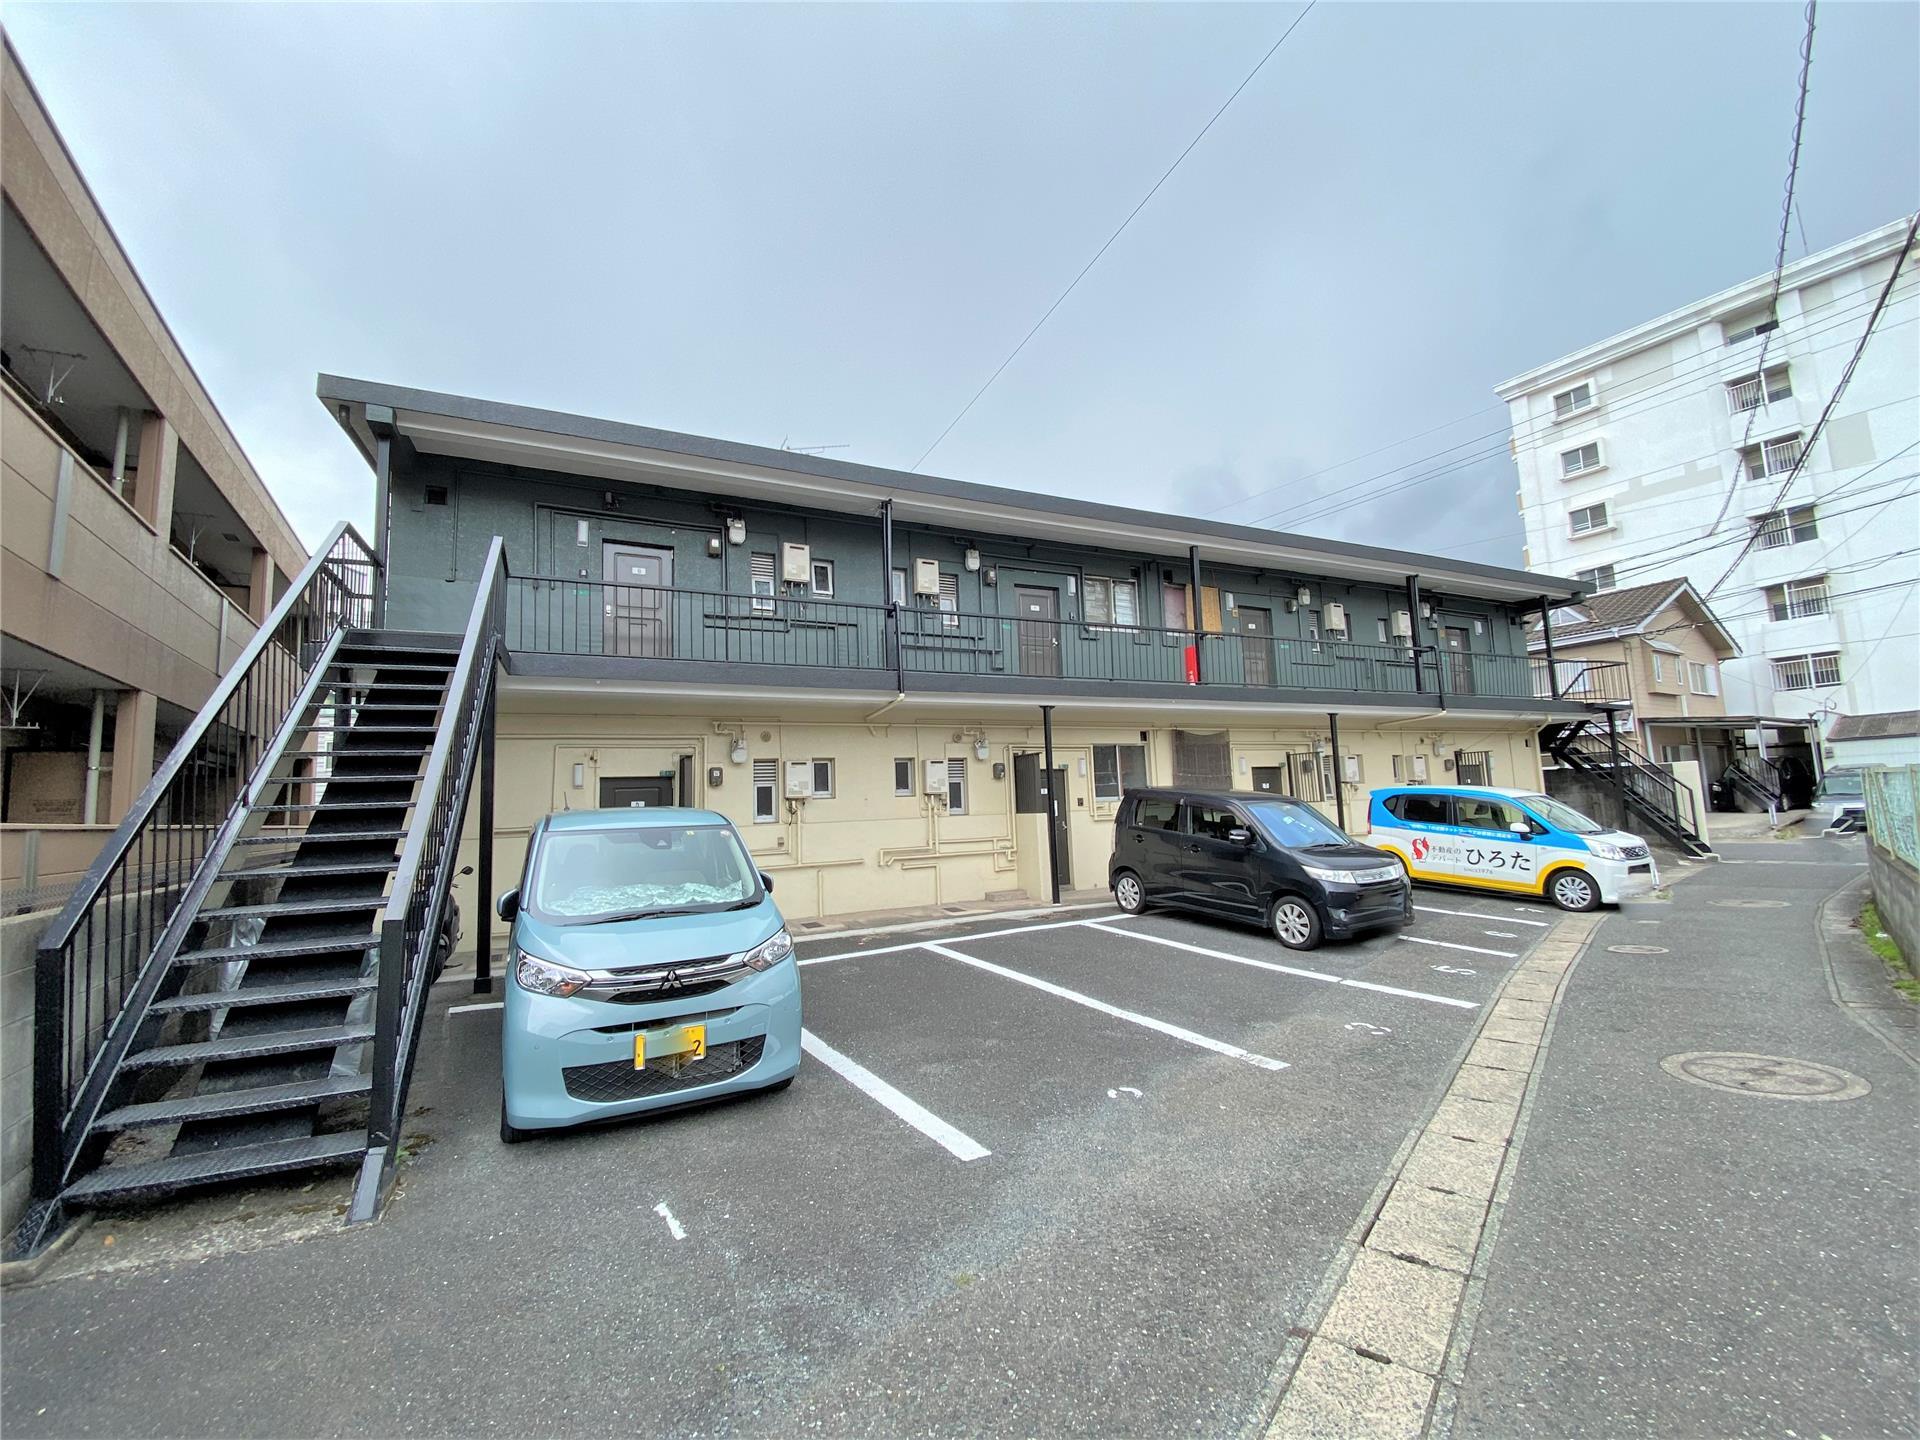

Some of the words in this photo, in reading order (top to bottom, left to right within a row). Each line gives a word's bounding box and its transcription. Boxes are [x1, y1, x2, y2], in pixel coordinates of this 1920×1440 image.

[1466, 848, 1531, 871] ひろた
[1430, 964, 1477, 976] 5
